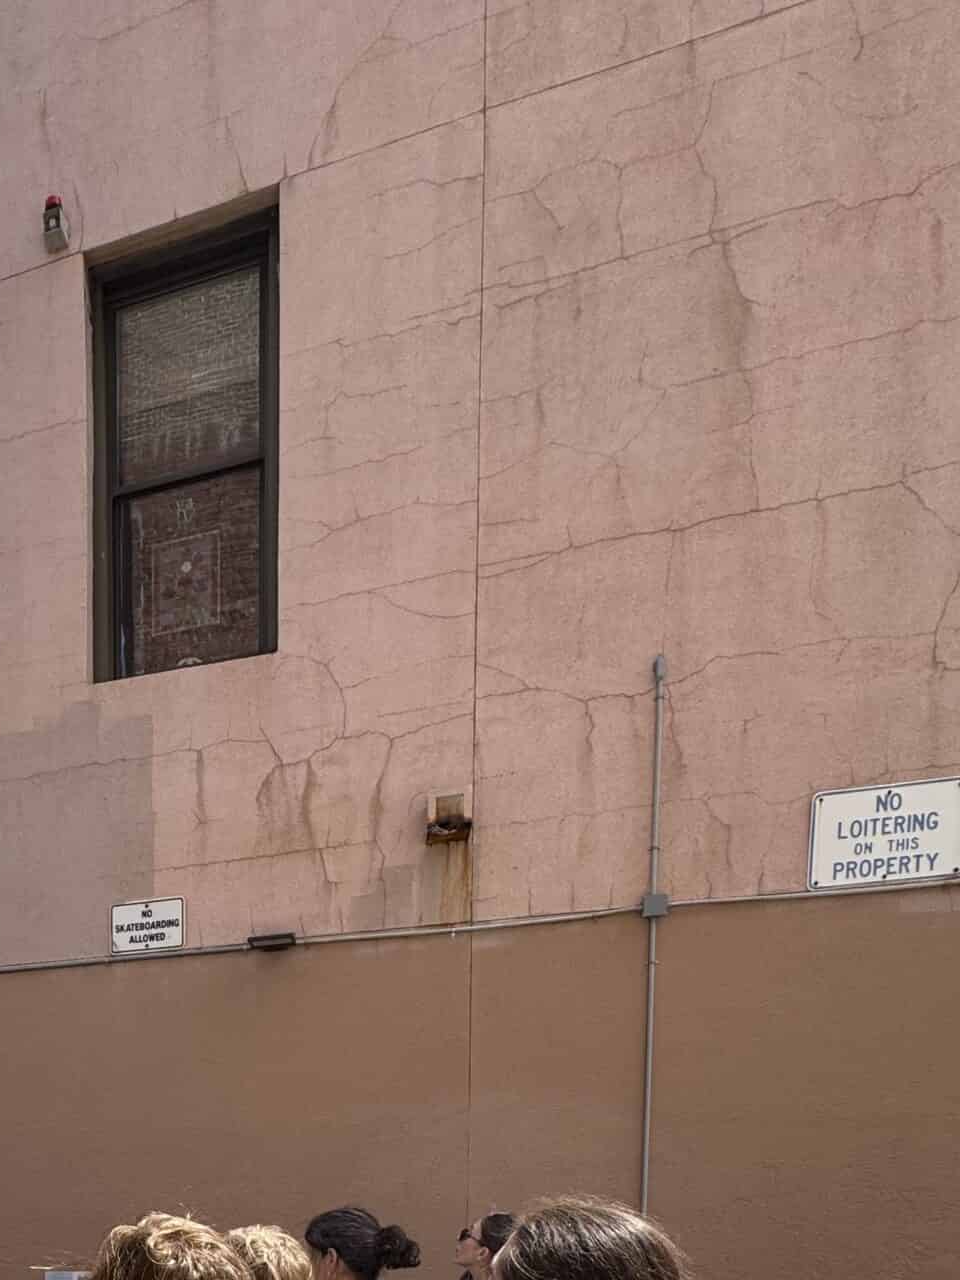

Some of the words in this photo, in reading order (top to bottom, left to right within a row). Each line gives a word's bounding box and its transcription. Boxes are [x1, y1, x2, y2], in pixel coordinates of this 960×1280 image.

[876, 793, 903, 813] NO
[837, 811, 940, 840] LOITERING
[854, 842, 873, 855] ON
[887, 837, 920, 852] THIS
[832, 852, 940, 881] PROPERTY
[141, 909, 153, 918] NO
[115, 918, 180, 933] SKATEBOARDING
[129, 932, 166, 944] ALLOWED
